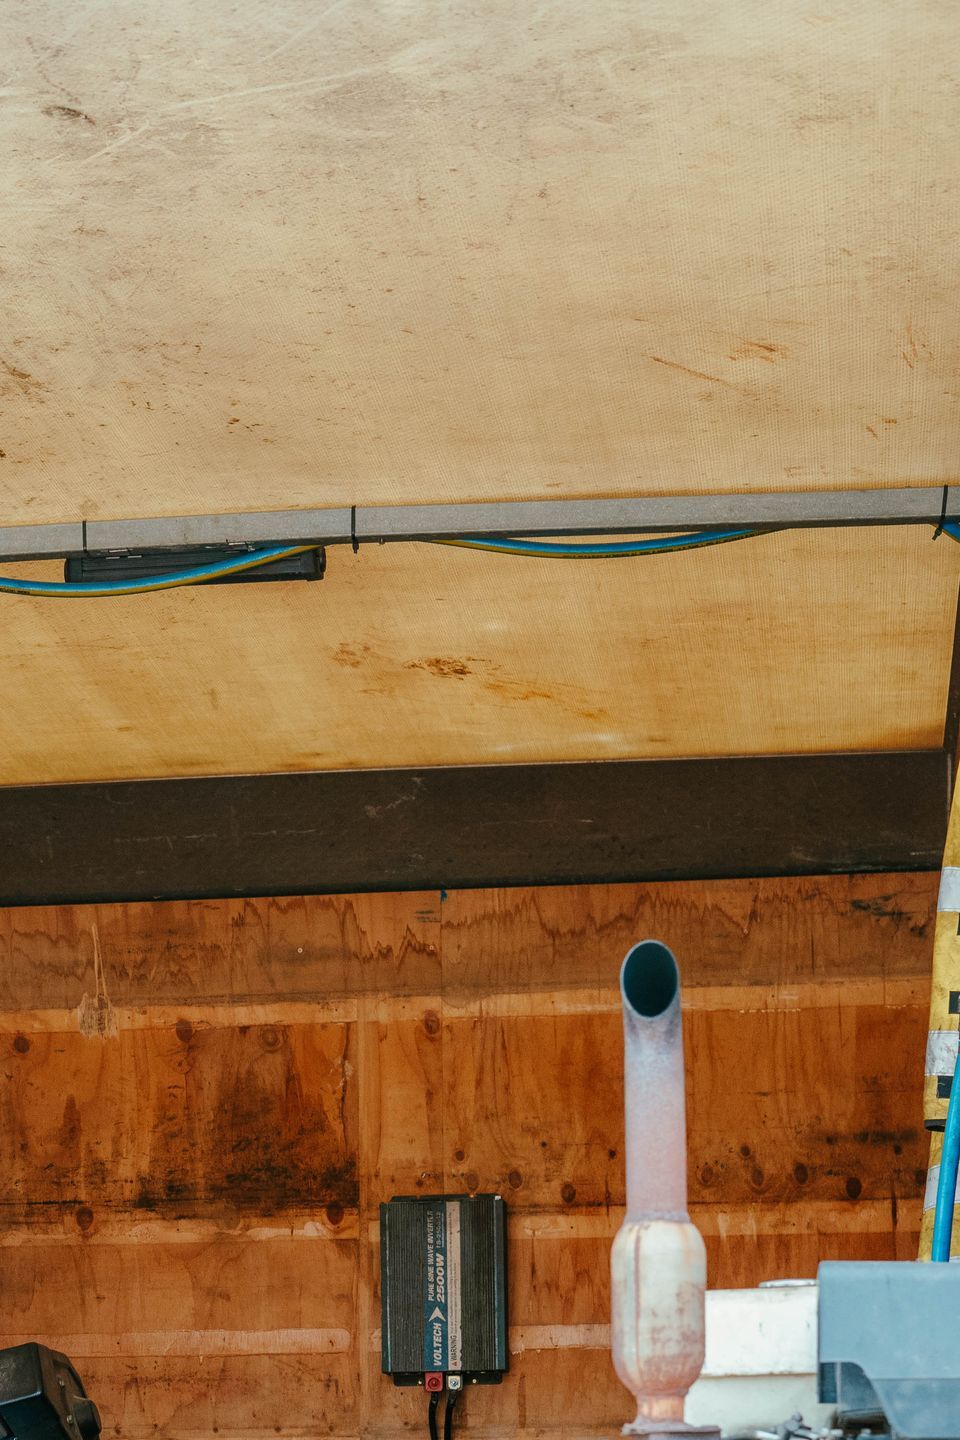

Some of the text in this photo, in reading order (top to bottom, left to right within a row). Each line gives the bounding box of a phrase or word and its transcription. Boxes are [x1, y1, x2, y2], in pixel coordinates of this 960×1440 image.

[427, 1244, 435, 1265] WAVE
[427, 1266, 435, 1282] SINE
[435, 1253, 445, 1303] 2500W
[427, 1283, 435, 1302] PURE
[432, 1322, 443, 1366] VOLTECH
[449, 1334, 458, 1361] WARNING
